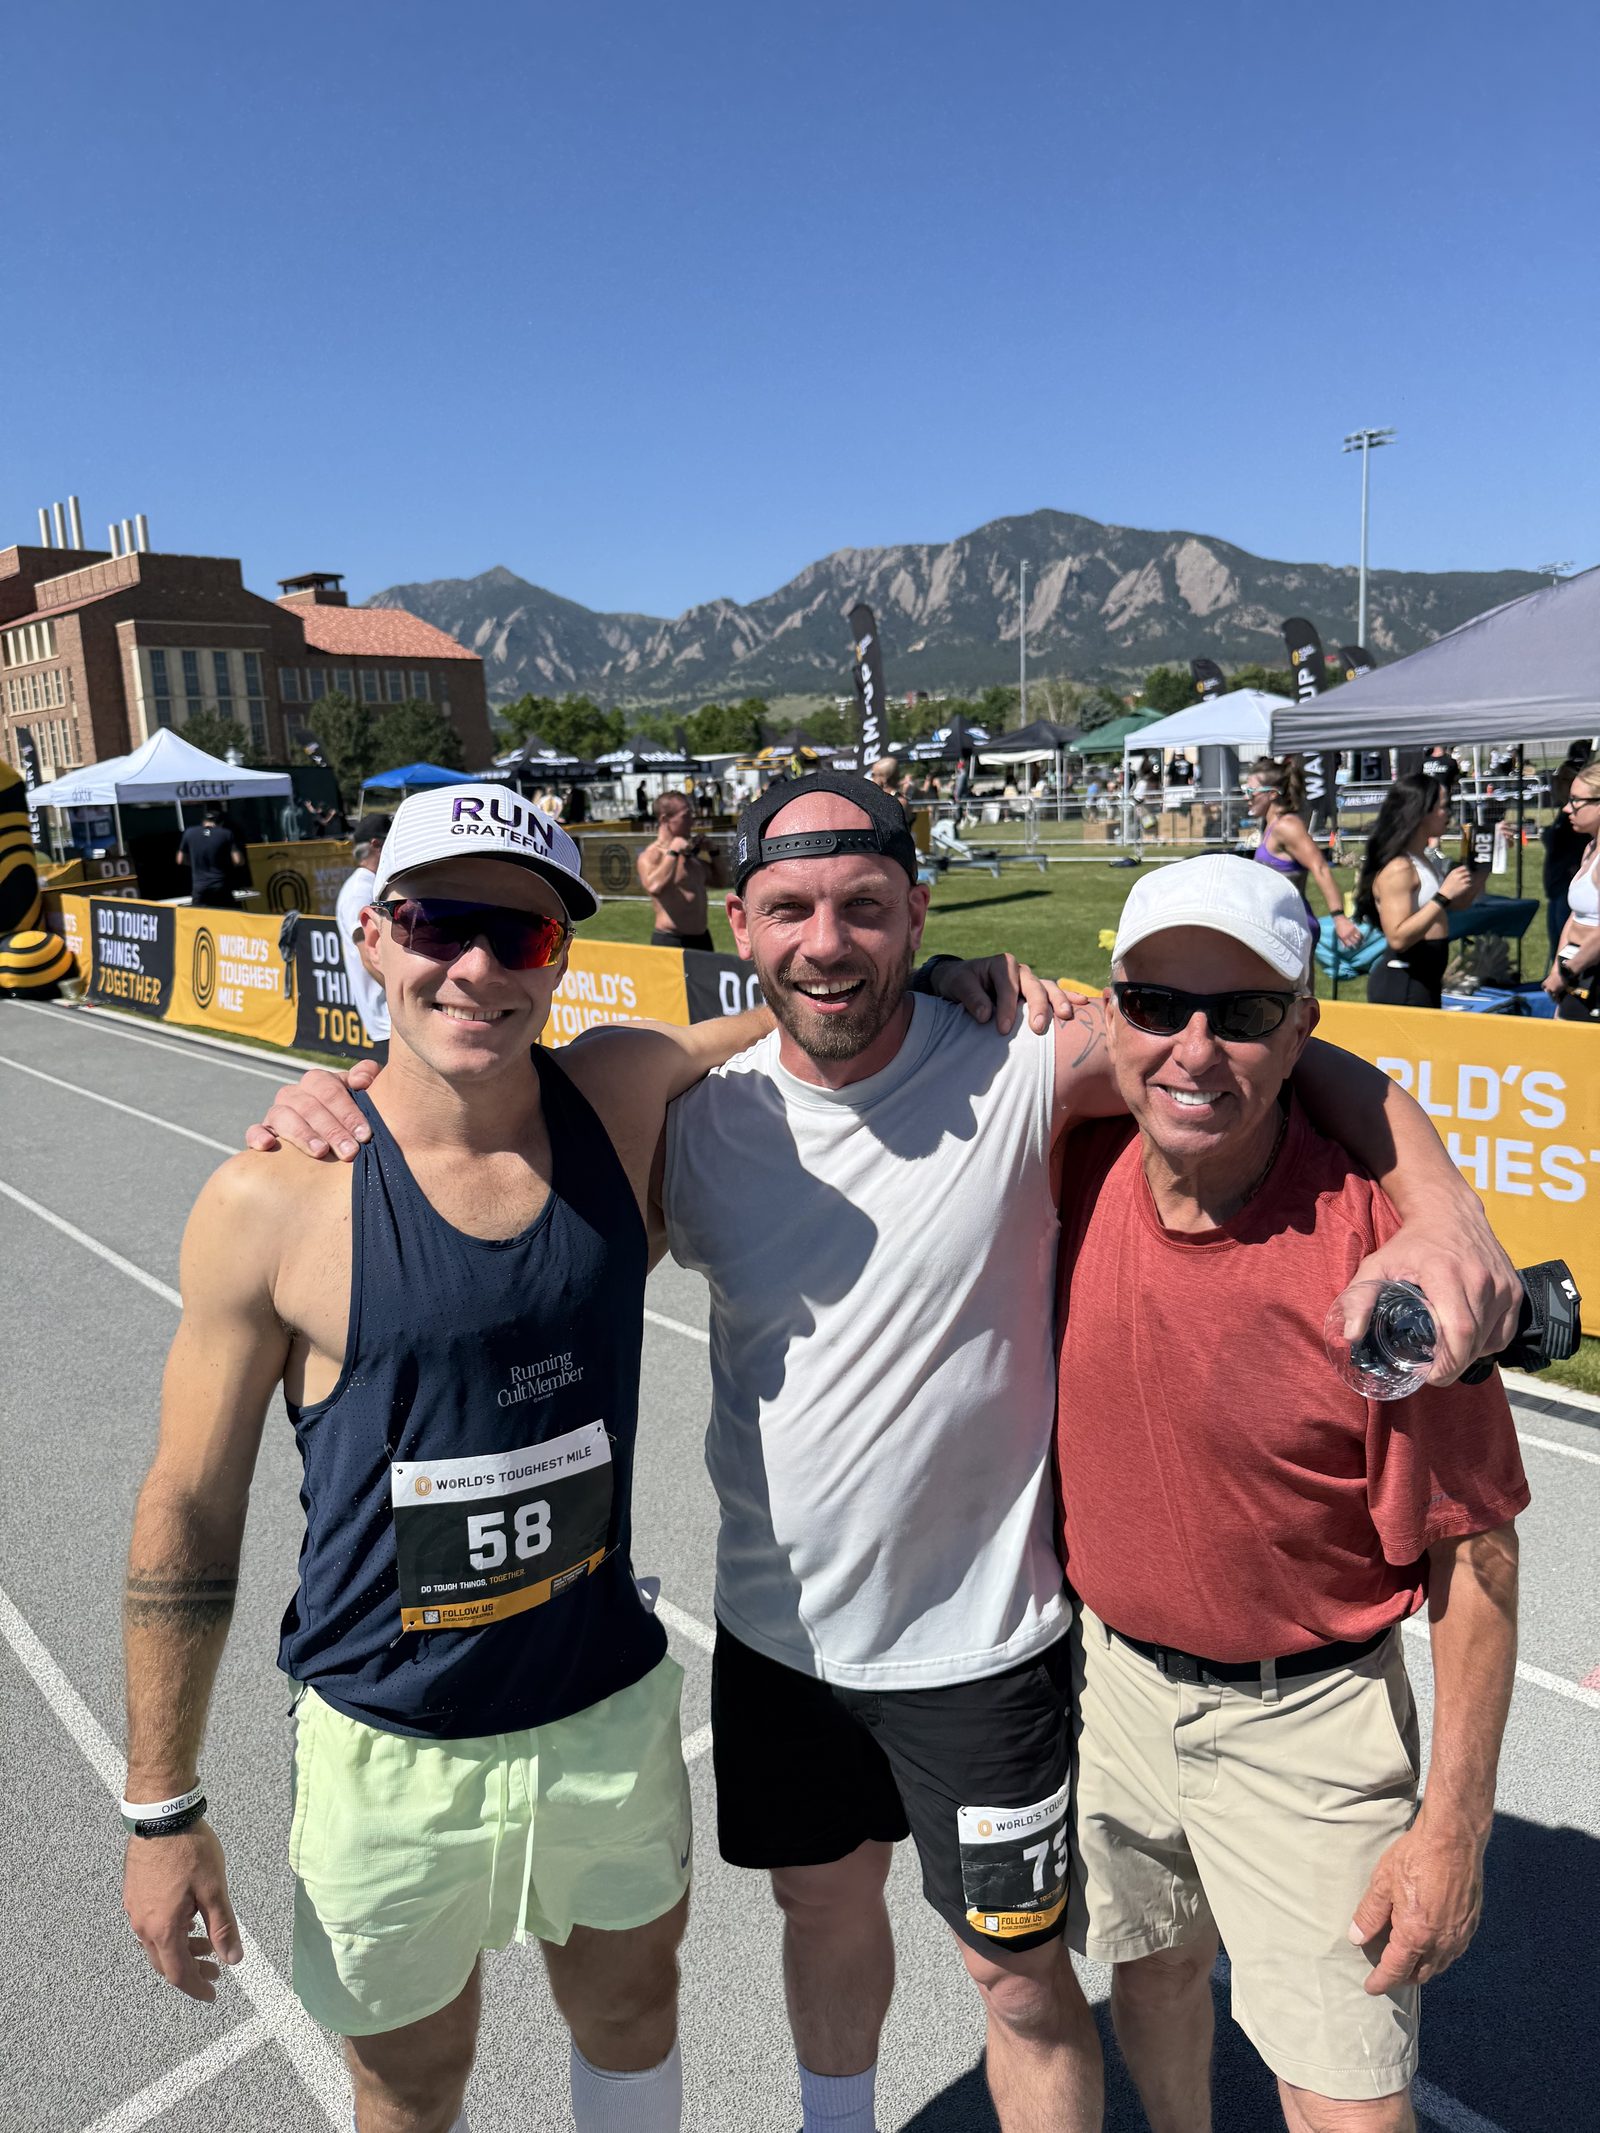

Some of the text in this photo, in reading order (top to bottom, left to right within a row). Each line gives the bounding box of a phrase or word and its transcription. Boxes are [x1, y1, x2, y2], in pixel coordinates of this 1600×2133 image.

[23, 760, 41, 844] RECOERY
[176, 780, 235, 799] dóttir
[451, 797, 554, 850] RUN
[1474, 833, 1493, 864] 204
[97, 908, 159, 943] DO TOUGH
[98, 937, 145, 975] THINGS,
[218, 934, 269, 962] WORLD'S
[310, 930, 340, 965] DO
[219, 961, 280, 991] TOUGHEST
[217, 987, 245, 1013] MILE
[509, 1351, 574, 1385] Running
[436, 1445, 593, 1491] WORLD'S TOUGHEST MILE
[466, 1499, 552, 1571] 58
[421, 1585, 432, 1594] DO
[433, 1582, 458, 1592] TOUGH
[442, 1605, 481, 1618] FOLLOW
[481, 1602, 494, 1613] US
[161, 1800, 185, 1814] ONE
[996, 1811, 1042, 1832] WORLD'S
[1001, 1914, 1032, 1926] FOLLOW
